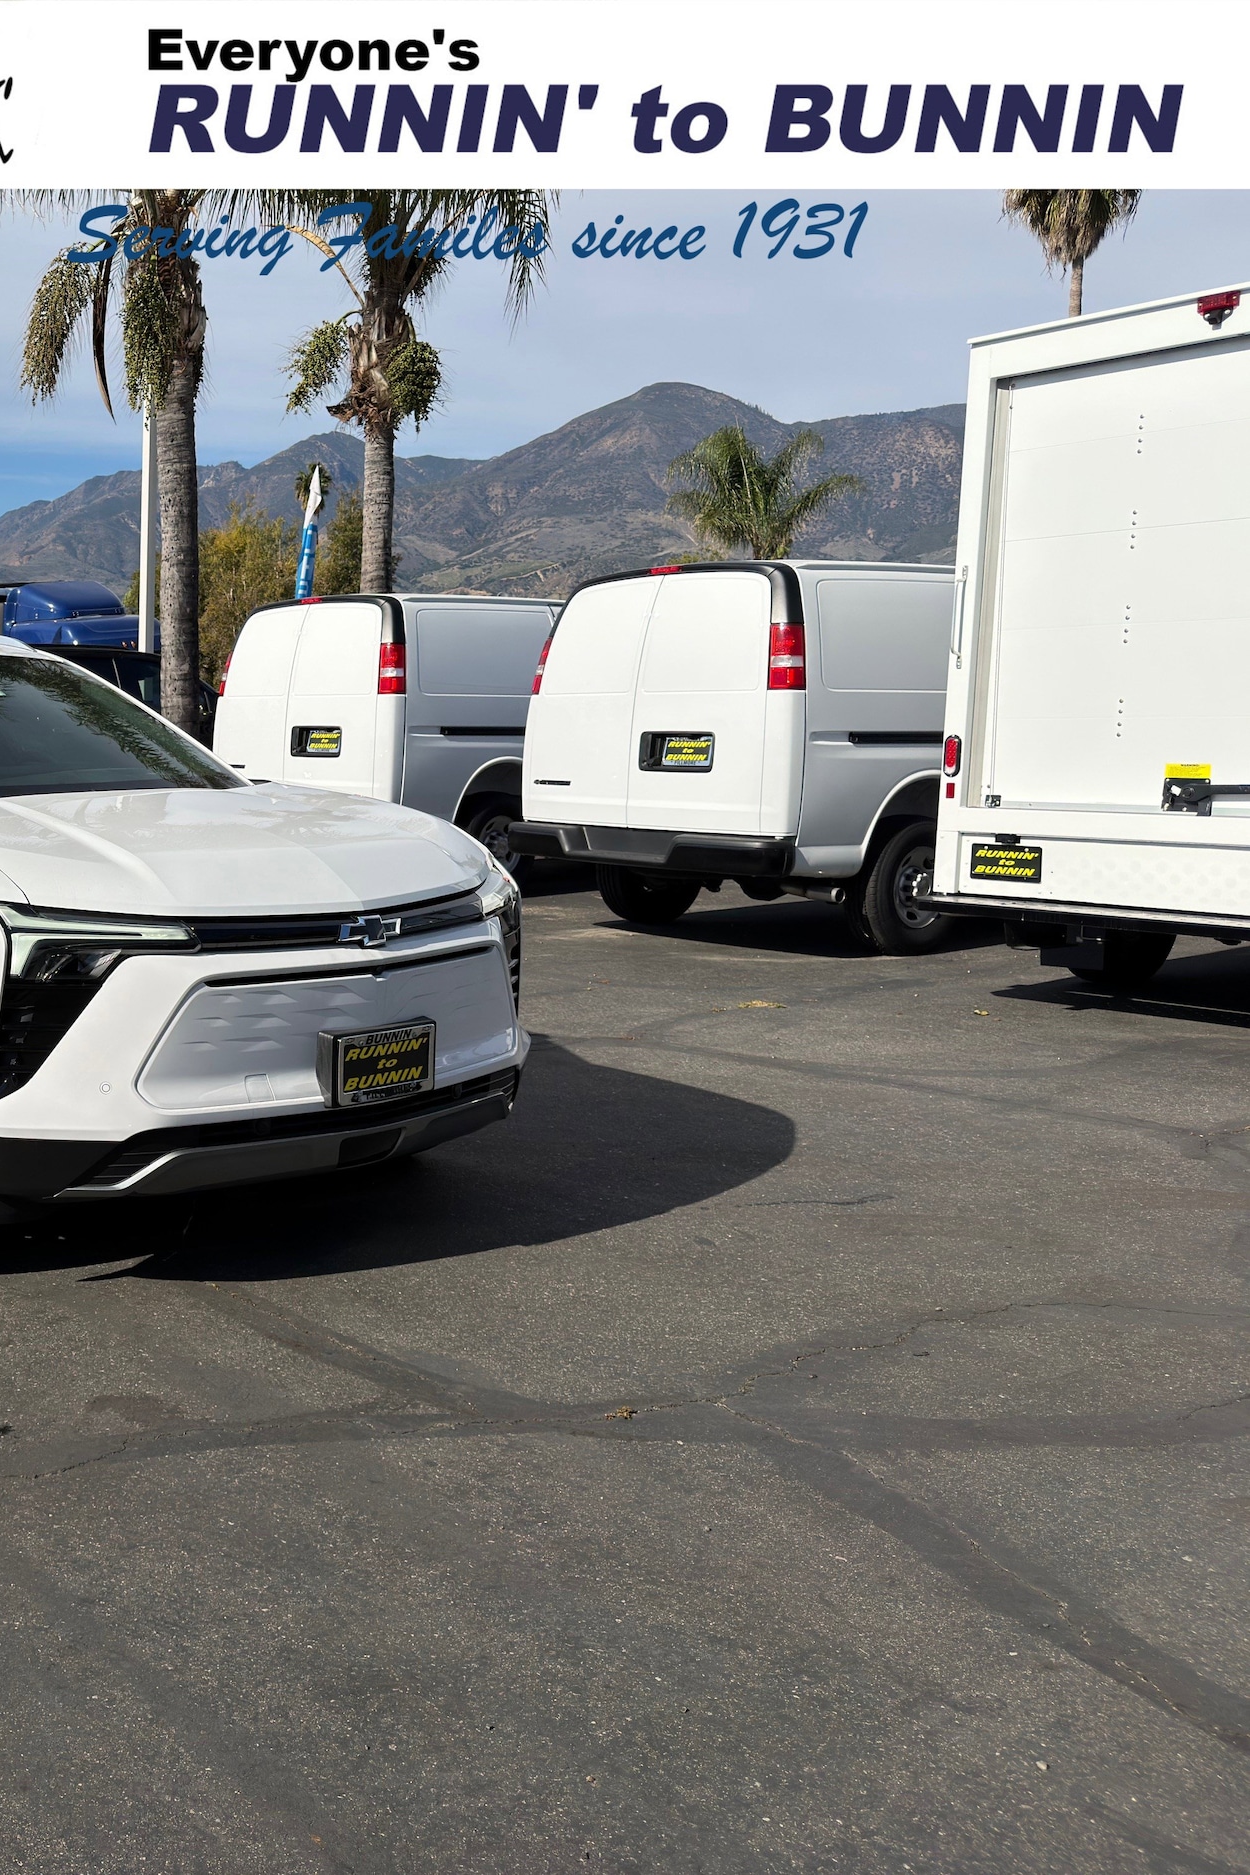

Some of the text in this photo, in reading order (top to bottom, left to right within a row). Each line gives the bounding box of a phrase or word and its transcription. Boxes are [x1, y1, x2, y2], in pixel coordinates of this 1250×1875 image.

[975, 849, 1039, 860] RUNNIN'
[974, 865, 1035, 876] BUNNIN
[365, 1029, 413, 1046] BUNNIN
[344, 1037, 429, 1062] RUNNIN'
[376, 1058, 398, 1069] to
[343, 1065, 424, 1092] BUNNIN
